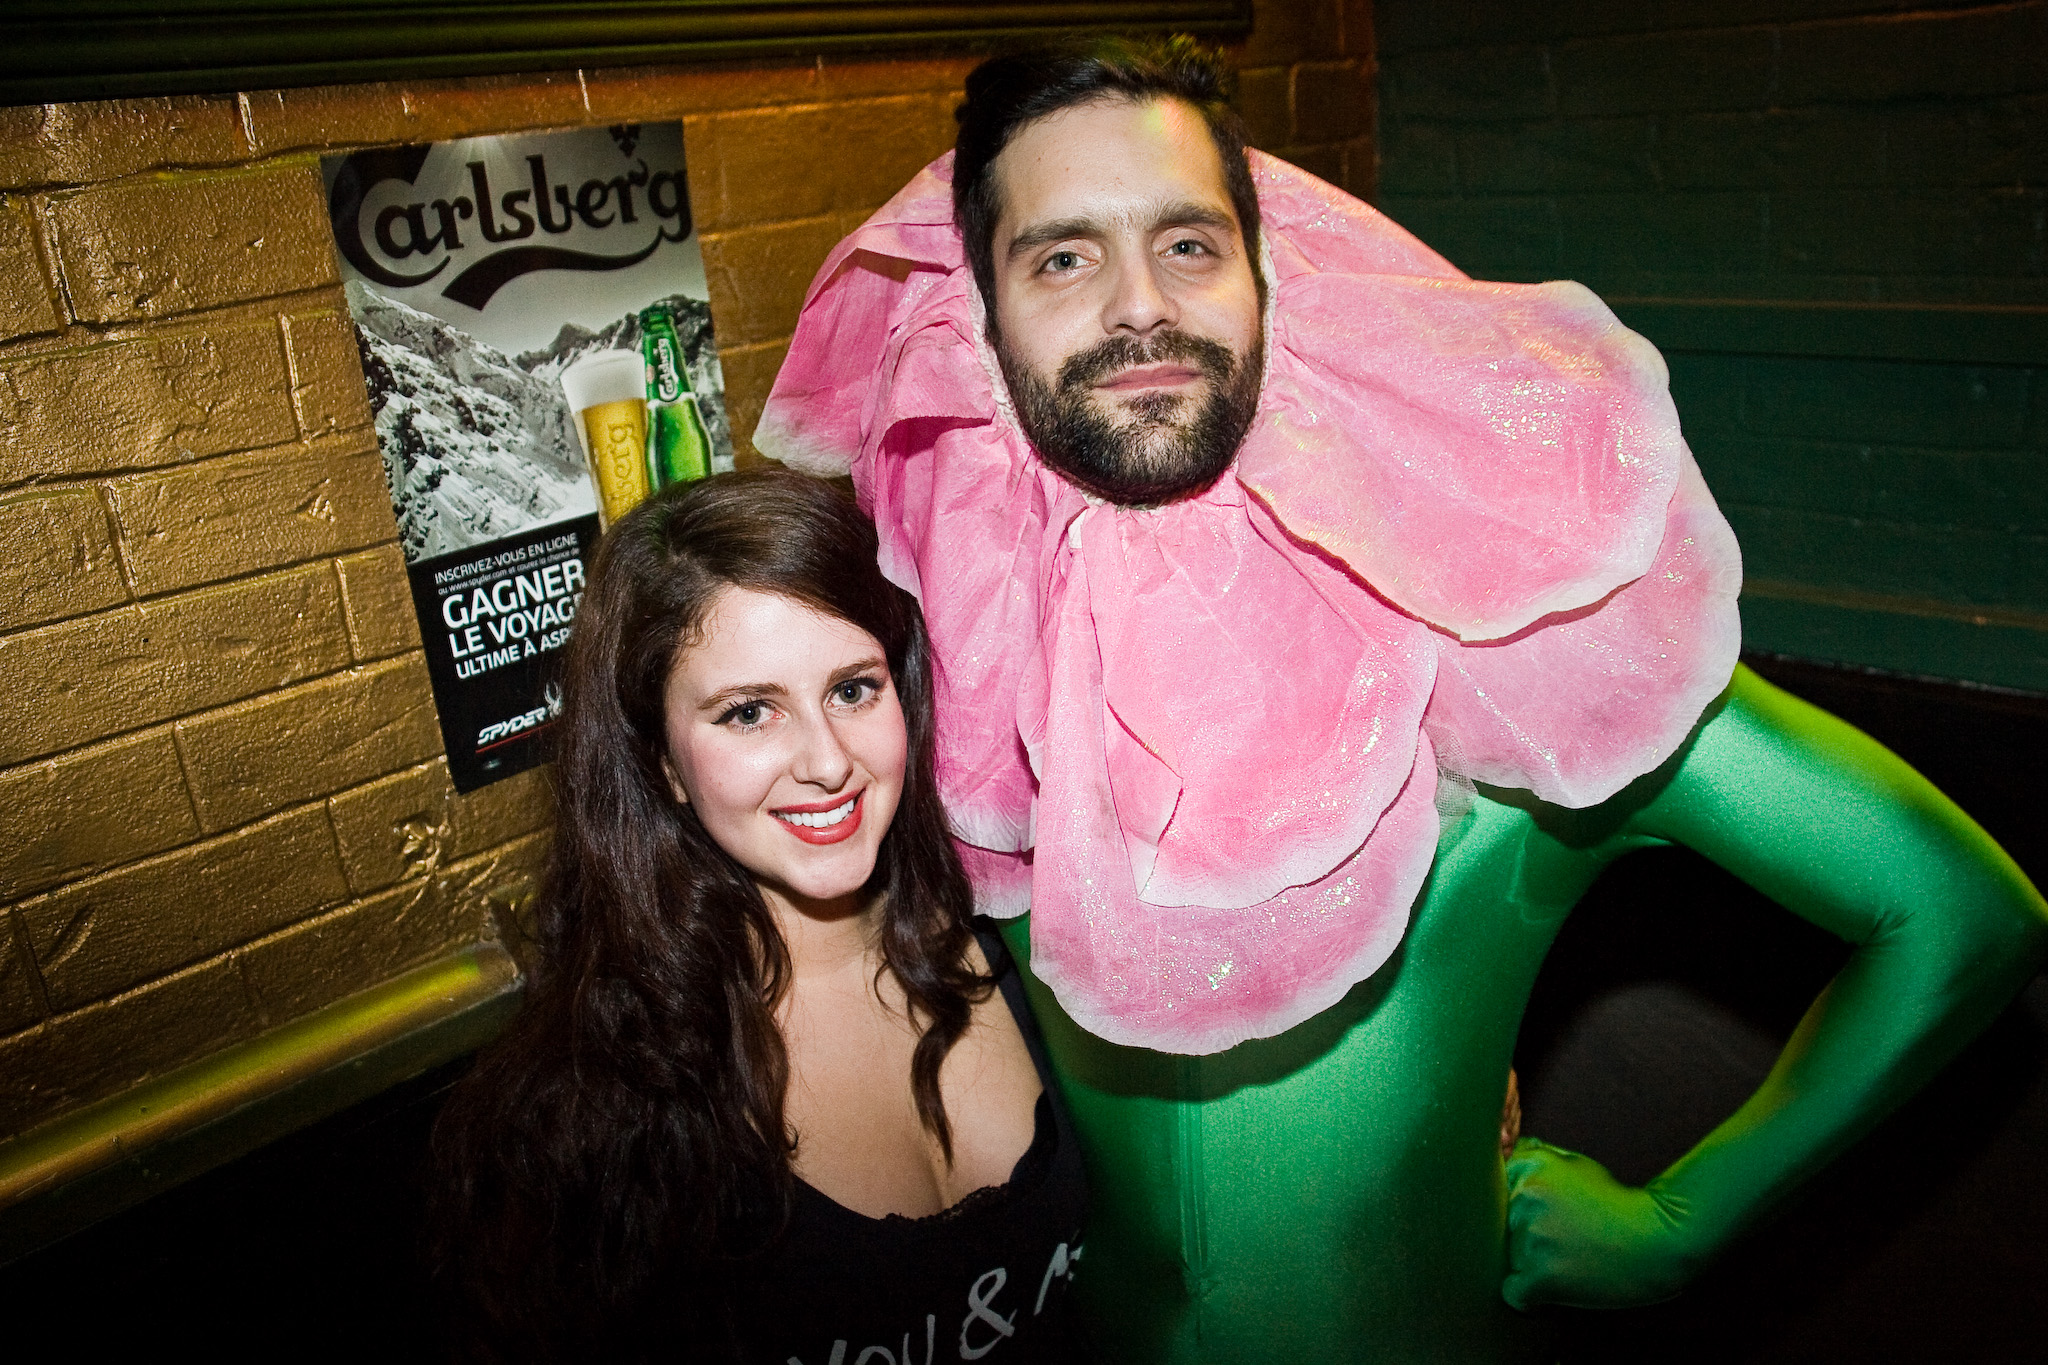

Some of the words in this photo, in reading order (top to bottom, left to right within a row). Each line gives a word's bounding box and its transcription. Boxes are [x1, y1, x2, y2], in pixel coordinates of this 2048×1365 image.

[330, 141, 693, 309] Carlsberg
[434, 547, 526, 585] INSCRIVEZ-VOUS
[527, 542, 545, 557] EN
[545, 532, 578, 552] LIGNE
[442, 558, 586, 629] GAGNER
[449, 625, 486, 659] LE
[455, 643, 521, 680] ULTIME
[523, 636, 538, 658] À
[540, 627, 572, 653] ASP
[477, 706, 547, 745] SPYDER
[959, 1267, 1018, 1360] &
